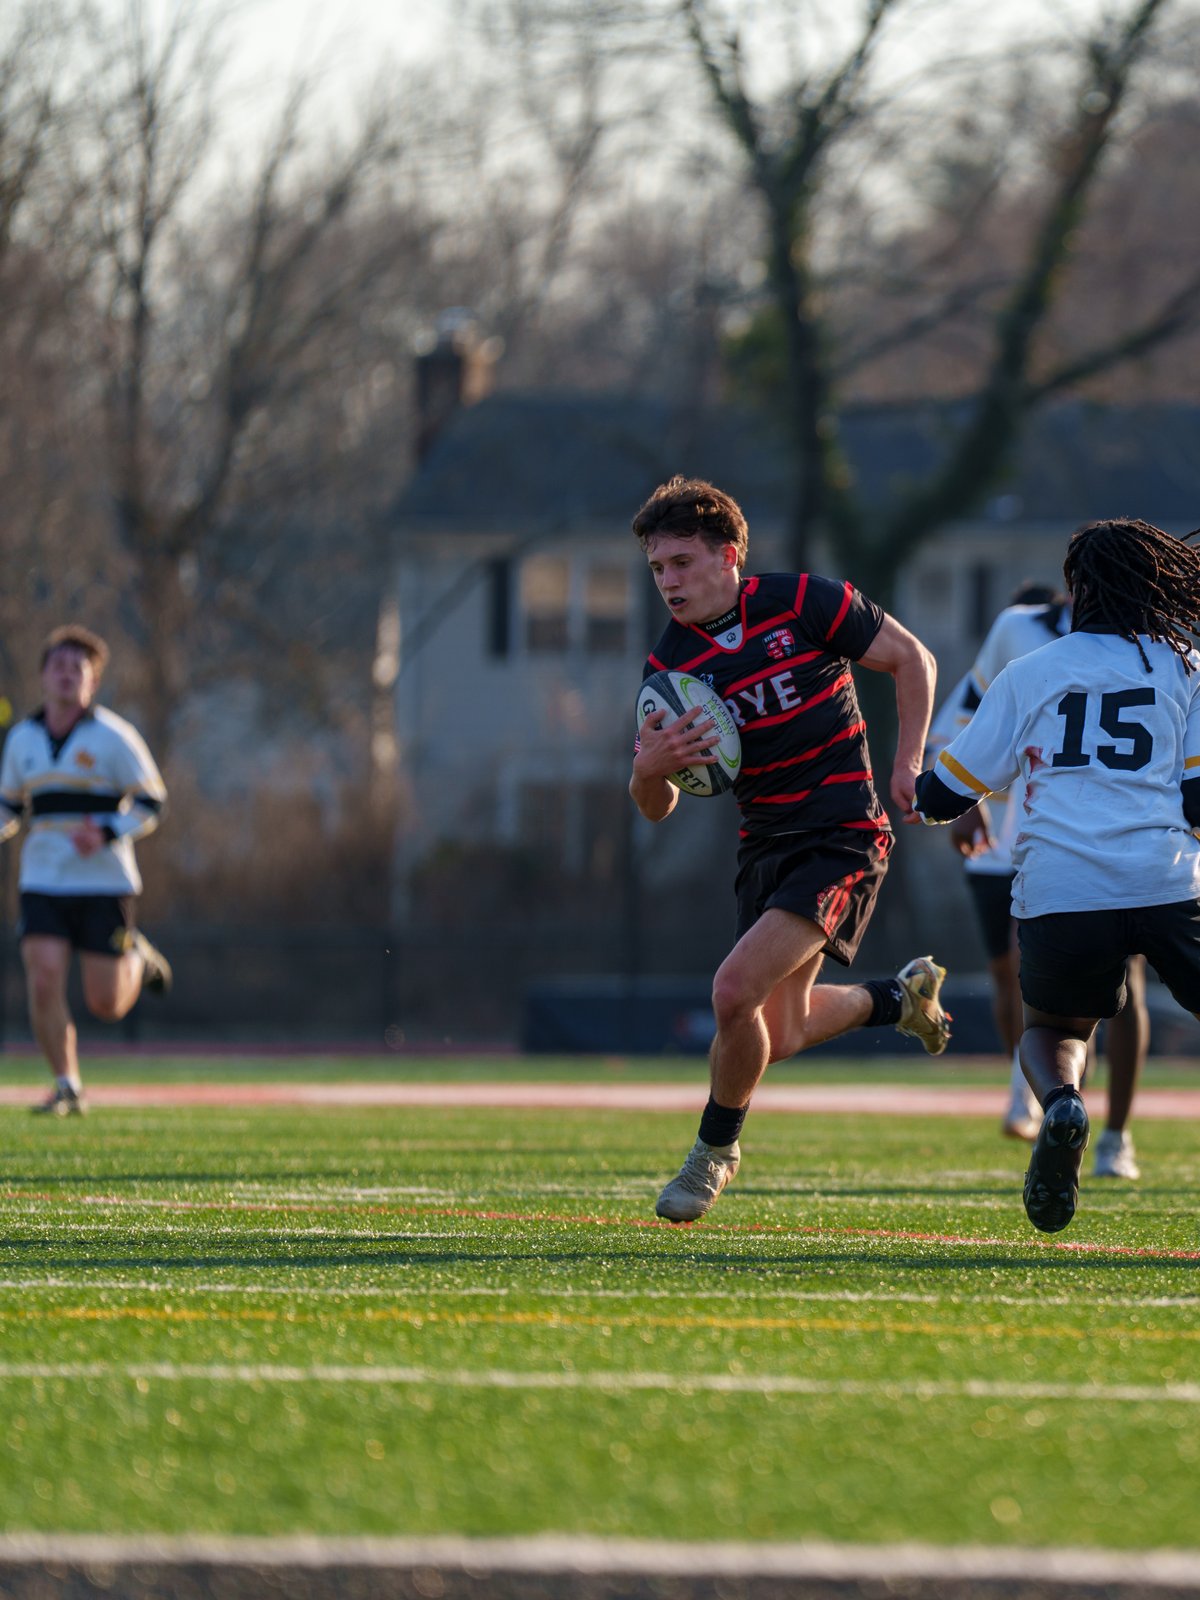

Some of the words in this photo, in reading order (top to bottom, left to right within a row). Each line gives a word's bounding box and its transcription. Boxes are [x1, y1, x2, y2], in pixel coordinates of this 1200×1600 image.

[705, 610, 737, 631] GILBERT
[706, 698, 733, 736] RUGBY
[711, 695, 736, 735] WORLD
[1052, 687, 1156, 771] 15
